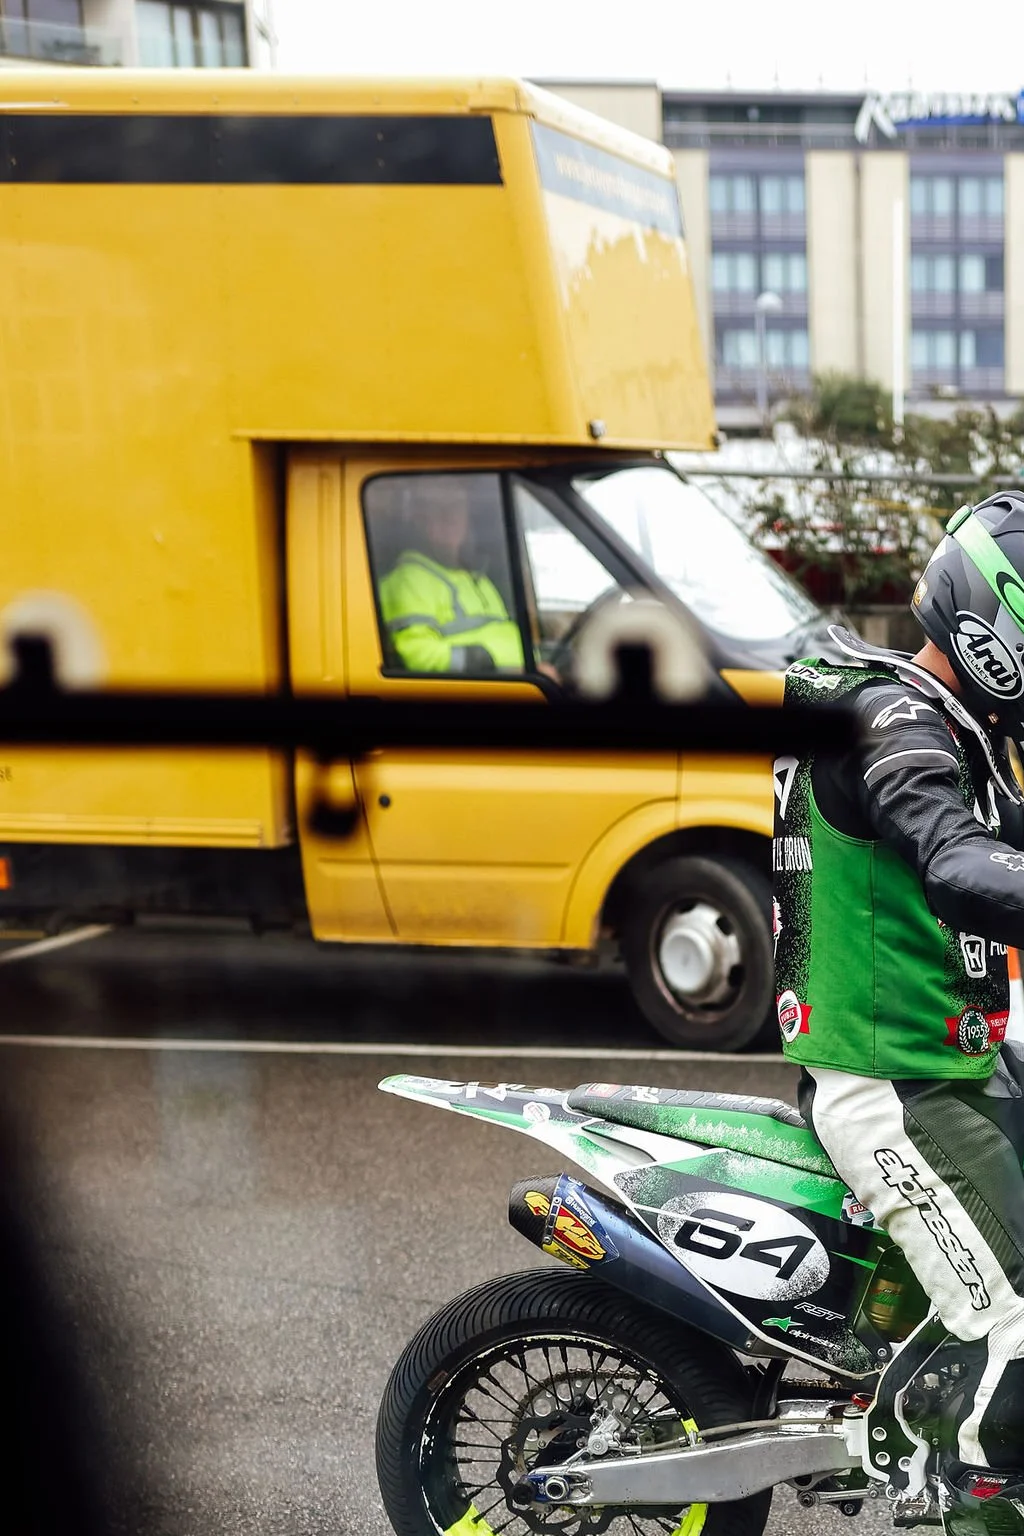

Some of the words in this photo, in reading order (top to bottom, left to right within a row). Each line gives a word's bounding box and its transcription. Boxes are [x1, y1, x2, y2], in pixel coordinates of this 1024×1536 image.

[966, 635, 1020, 687] Arai
[966, 1024, 986, 1041] 1955
[673, 1208, 817, 1281] 64
[793, 1301, 846, 1320] RST
